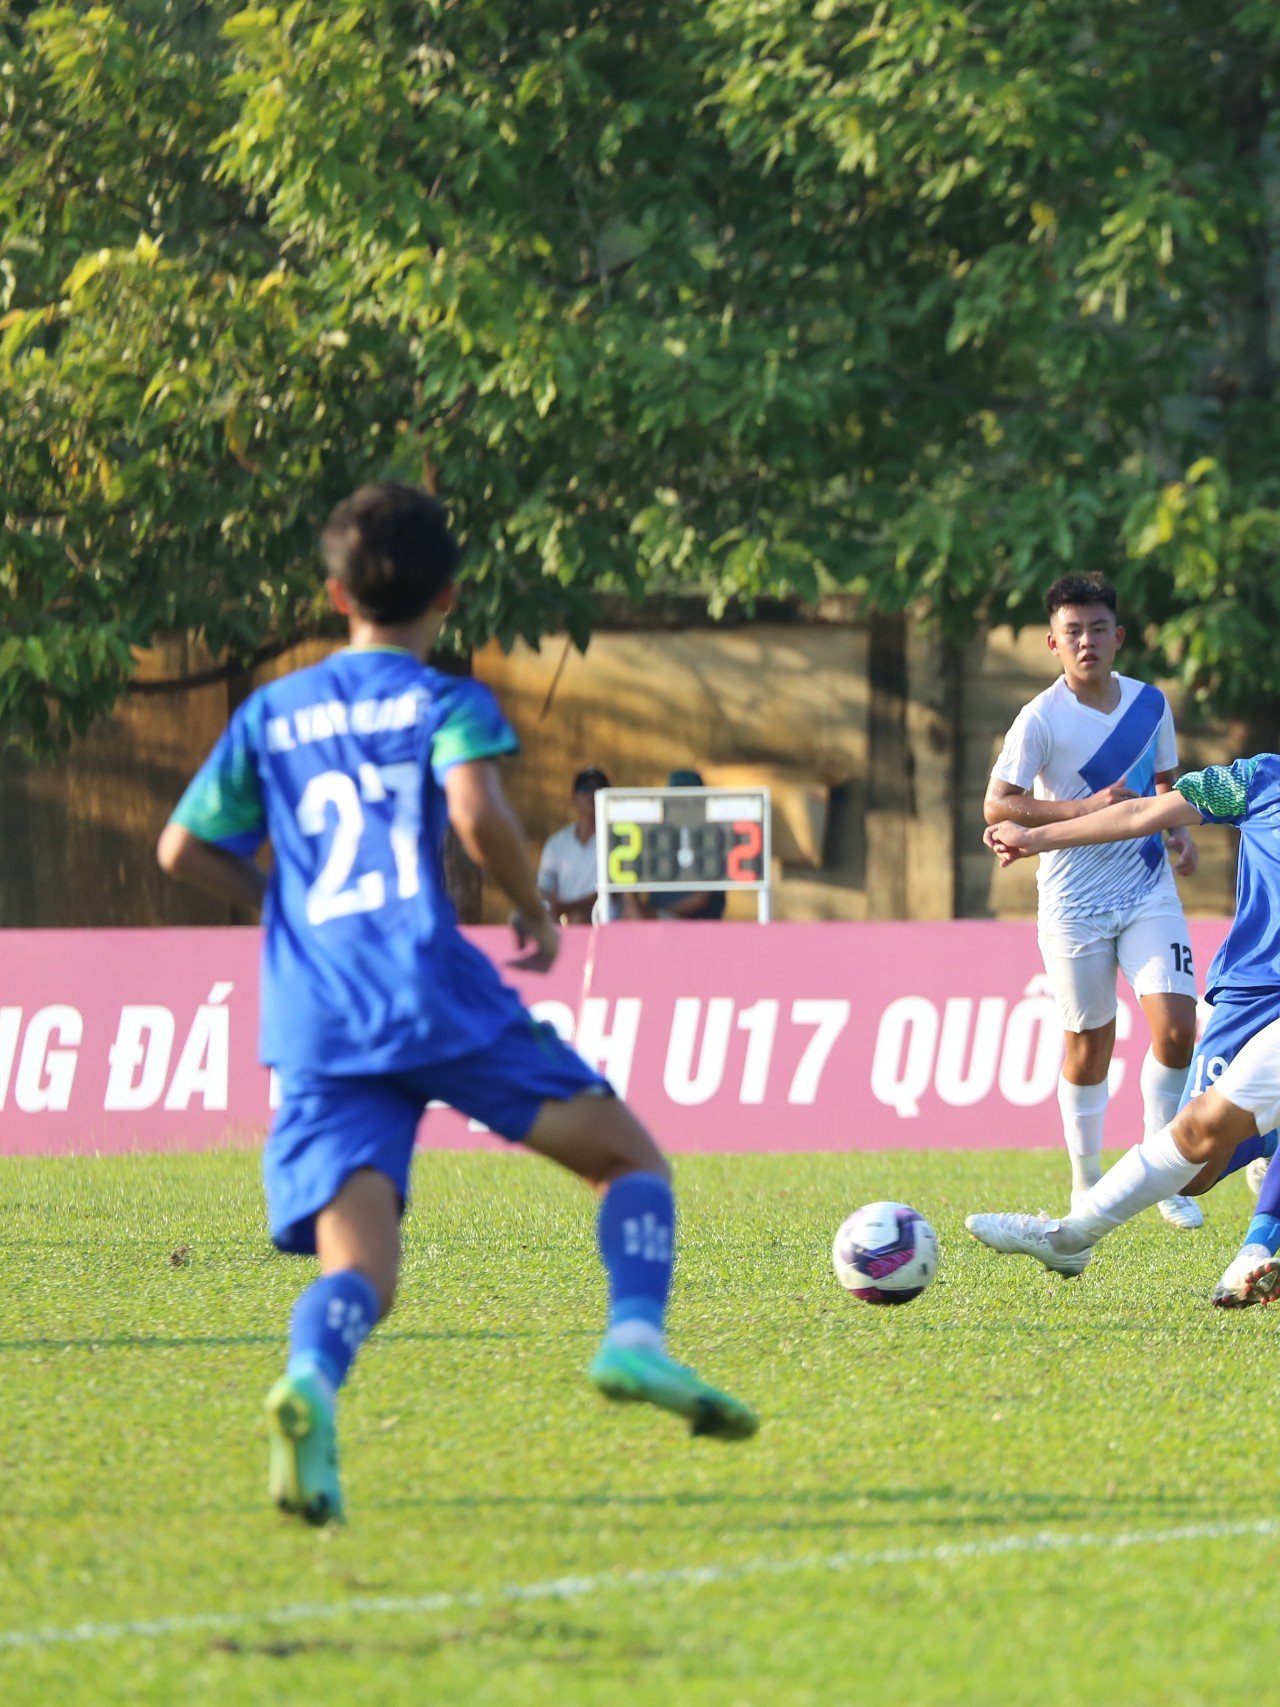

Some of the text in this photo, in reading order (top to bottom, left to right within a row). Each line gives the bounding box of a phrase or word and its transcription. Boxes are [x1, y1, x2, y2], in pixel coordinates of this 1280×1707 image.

[297, 761, 421, 926] 27
[609, 820, 762, 885] 2 2
[1171, 943, 1193, 976] 12
[104, 981, 234, 1111] ĐÁ
[663, 997, 850, 1105] U17
[1190, 1054, 1230, 1098] 19
